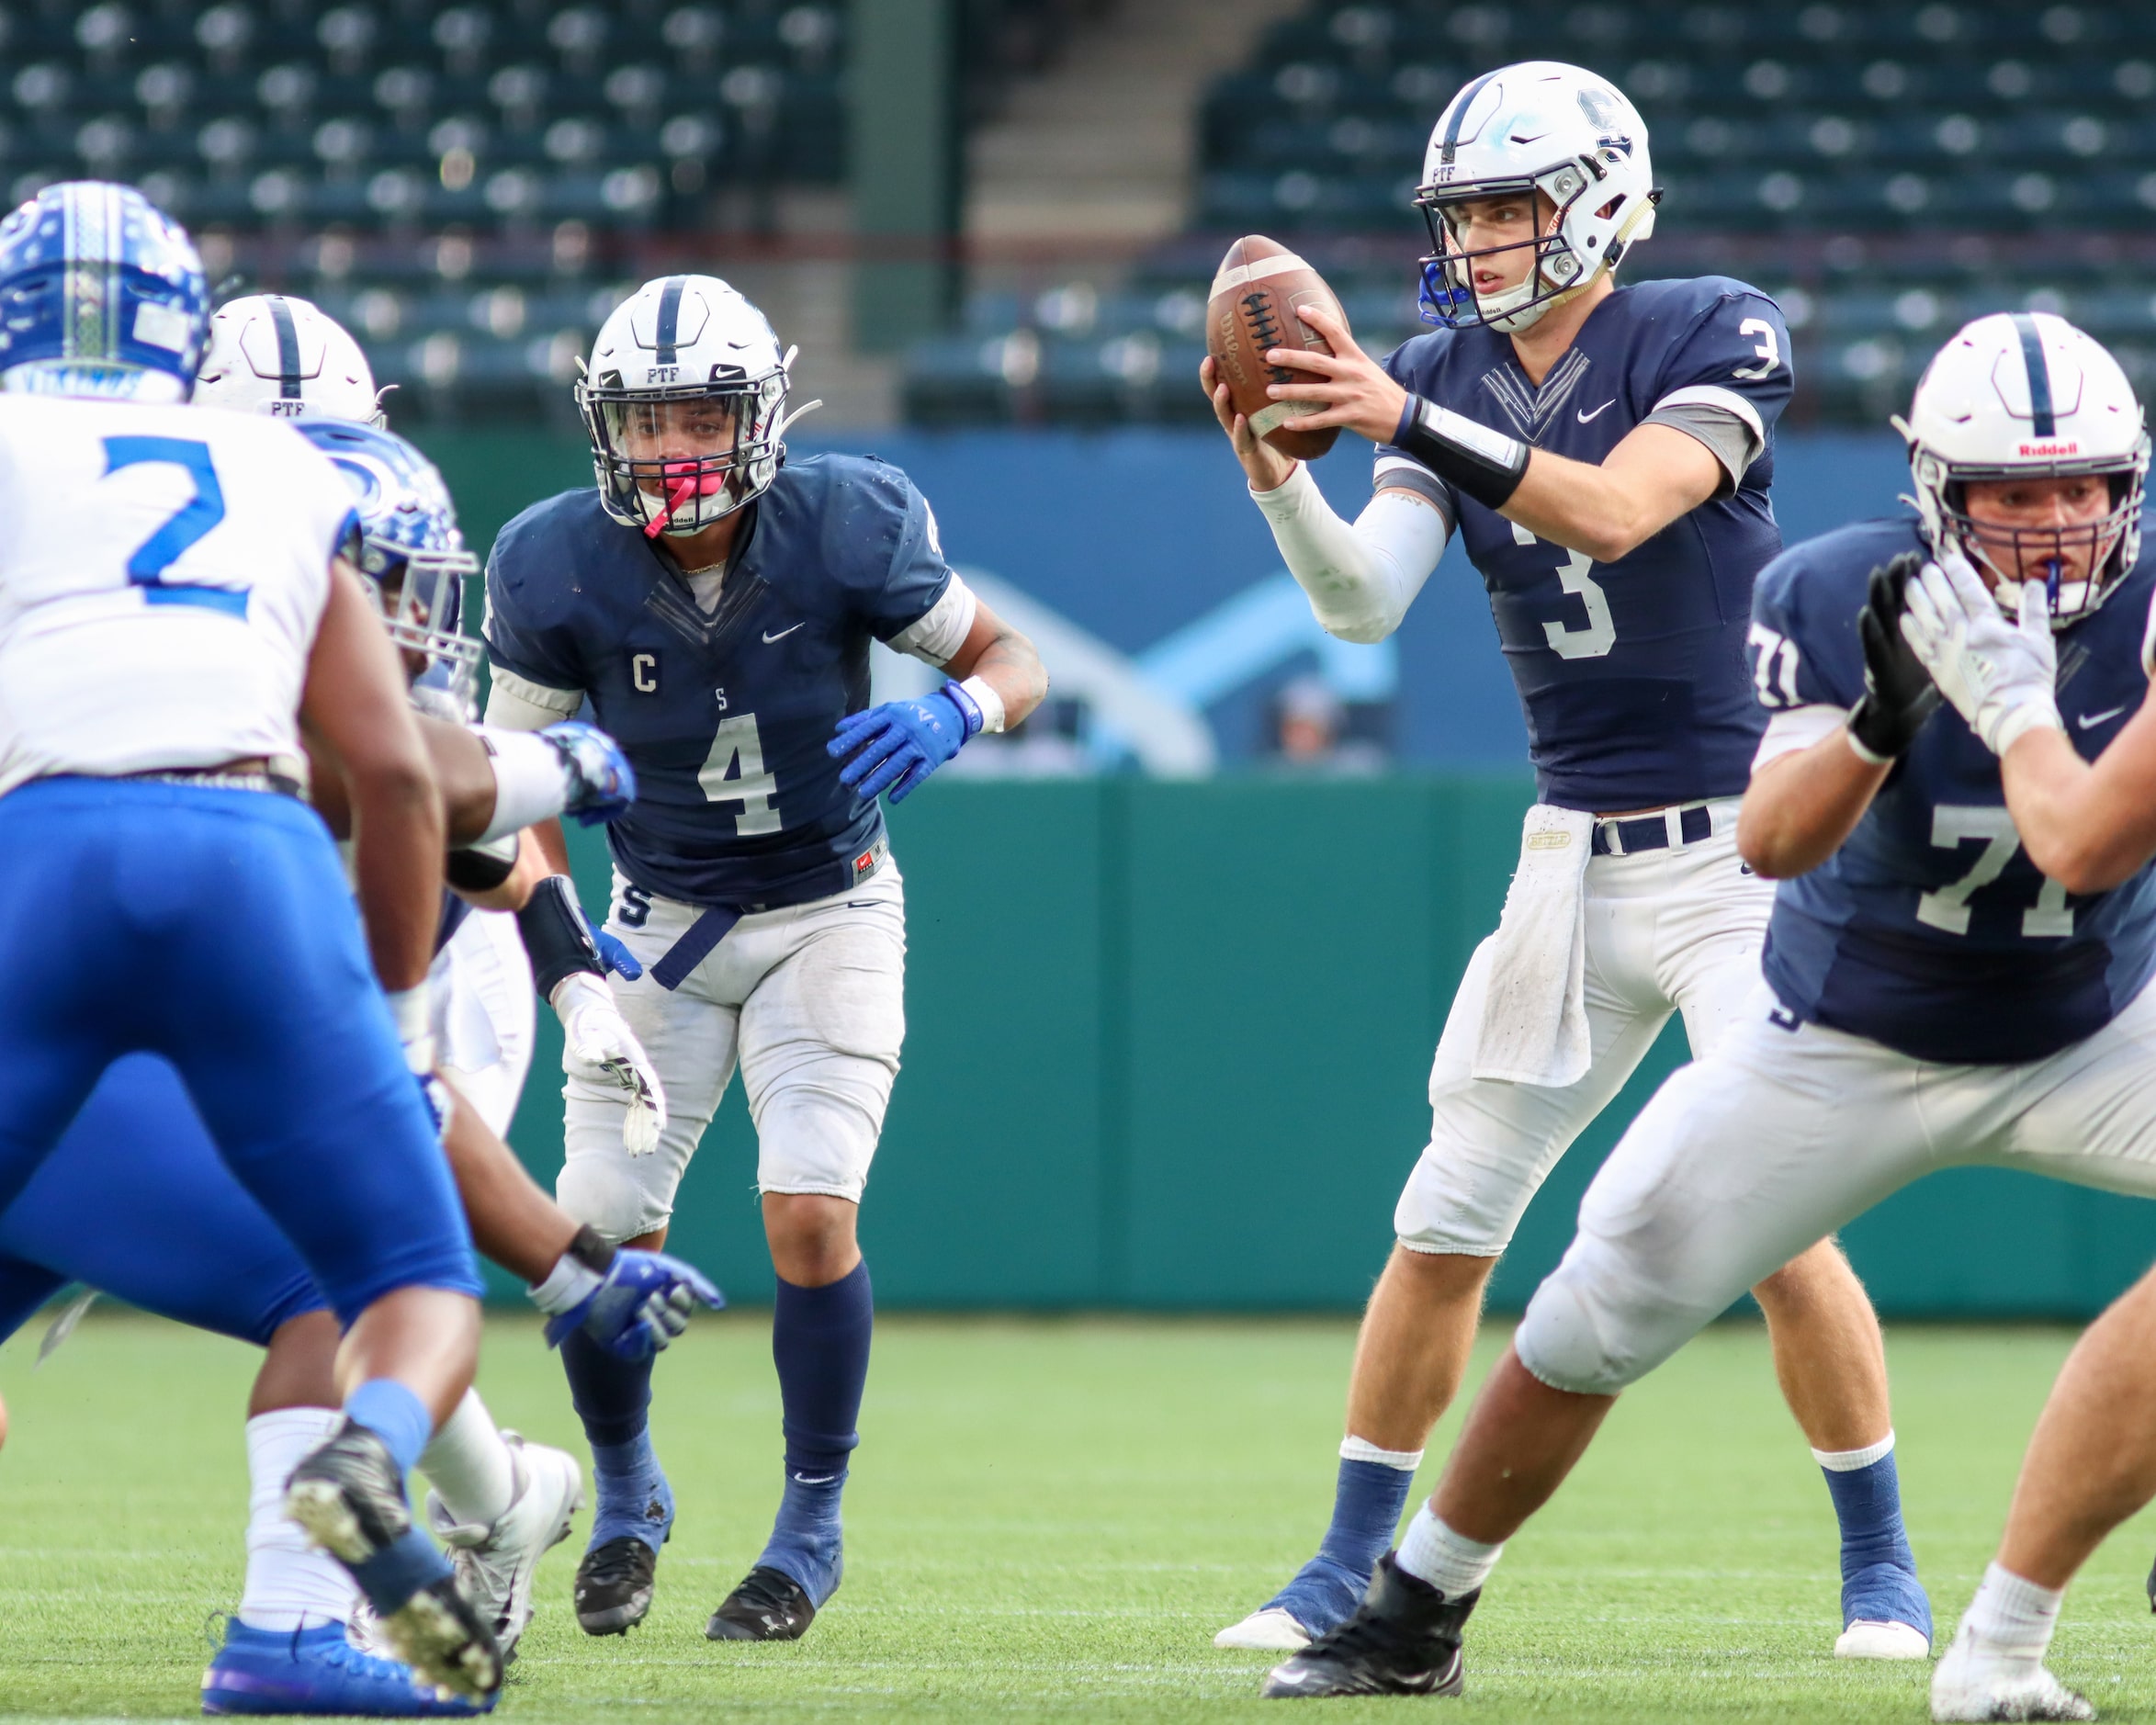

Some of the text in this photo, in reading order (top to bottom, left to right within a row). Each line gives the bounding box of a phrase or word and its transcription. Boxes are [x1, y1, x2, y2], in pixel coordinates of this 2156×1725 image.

[1433, 167, 1455, 183] PTF
[1220, 310, 1247, 386] Wilson
[1732, 318, 1779, 379] 3
[647, 367, 680, 384] PTF
[271, 401, 305, 417] PTF
[2019, 443, 2078, 457] Riddell
[99, 434, 253, 624] 2
[1511, 521, 1617, 660] 3
[632, 654, 657, 693] C
[1748, 622, 1803, 707] 71
[715, 687, 728, 712] S
[697, 712, 783, 836] 4
[618, 885, 652, 929] S
